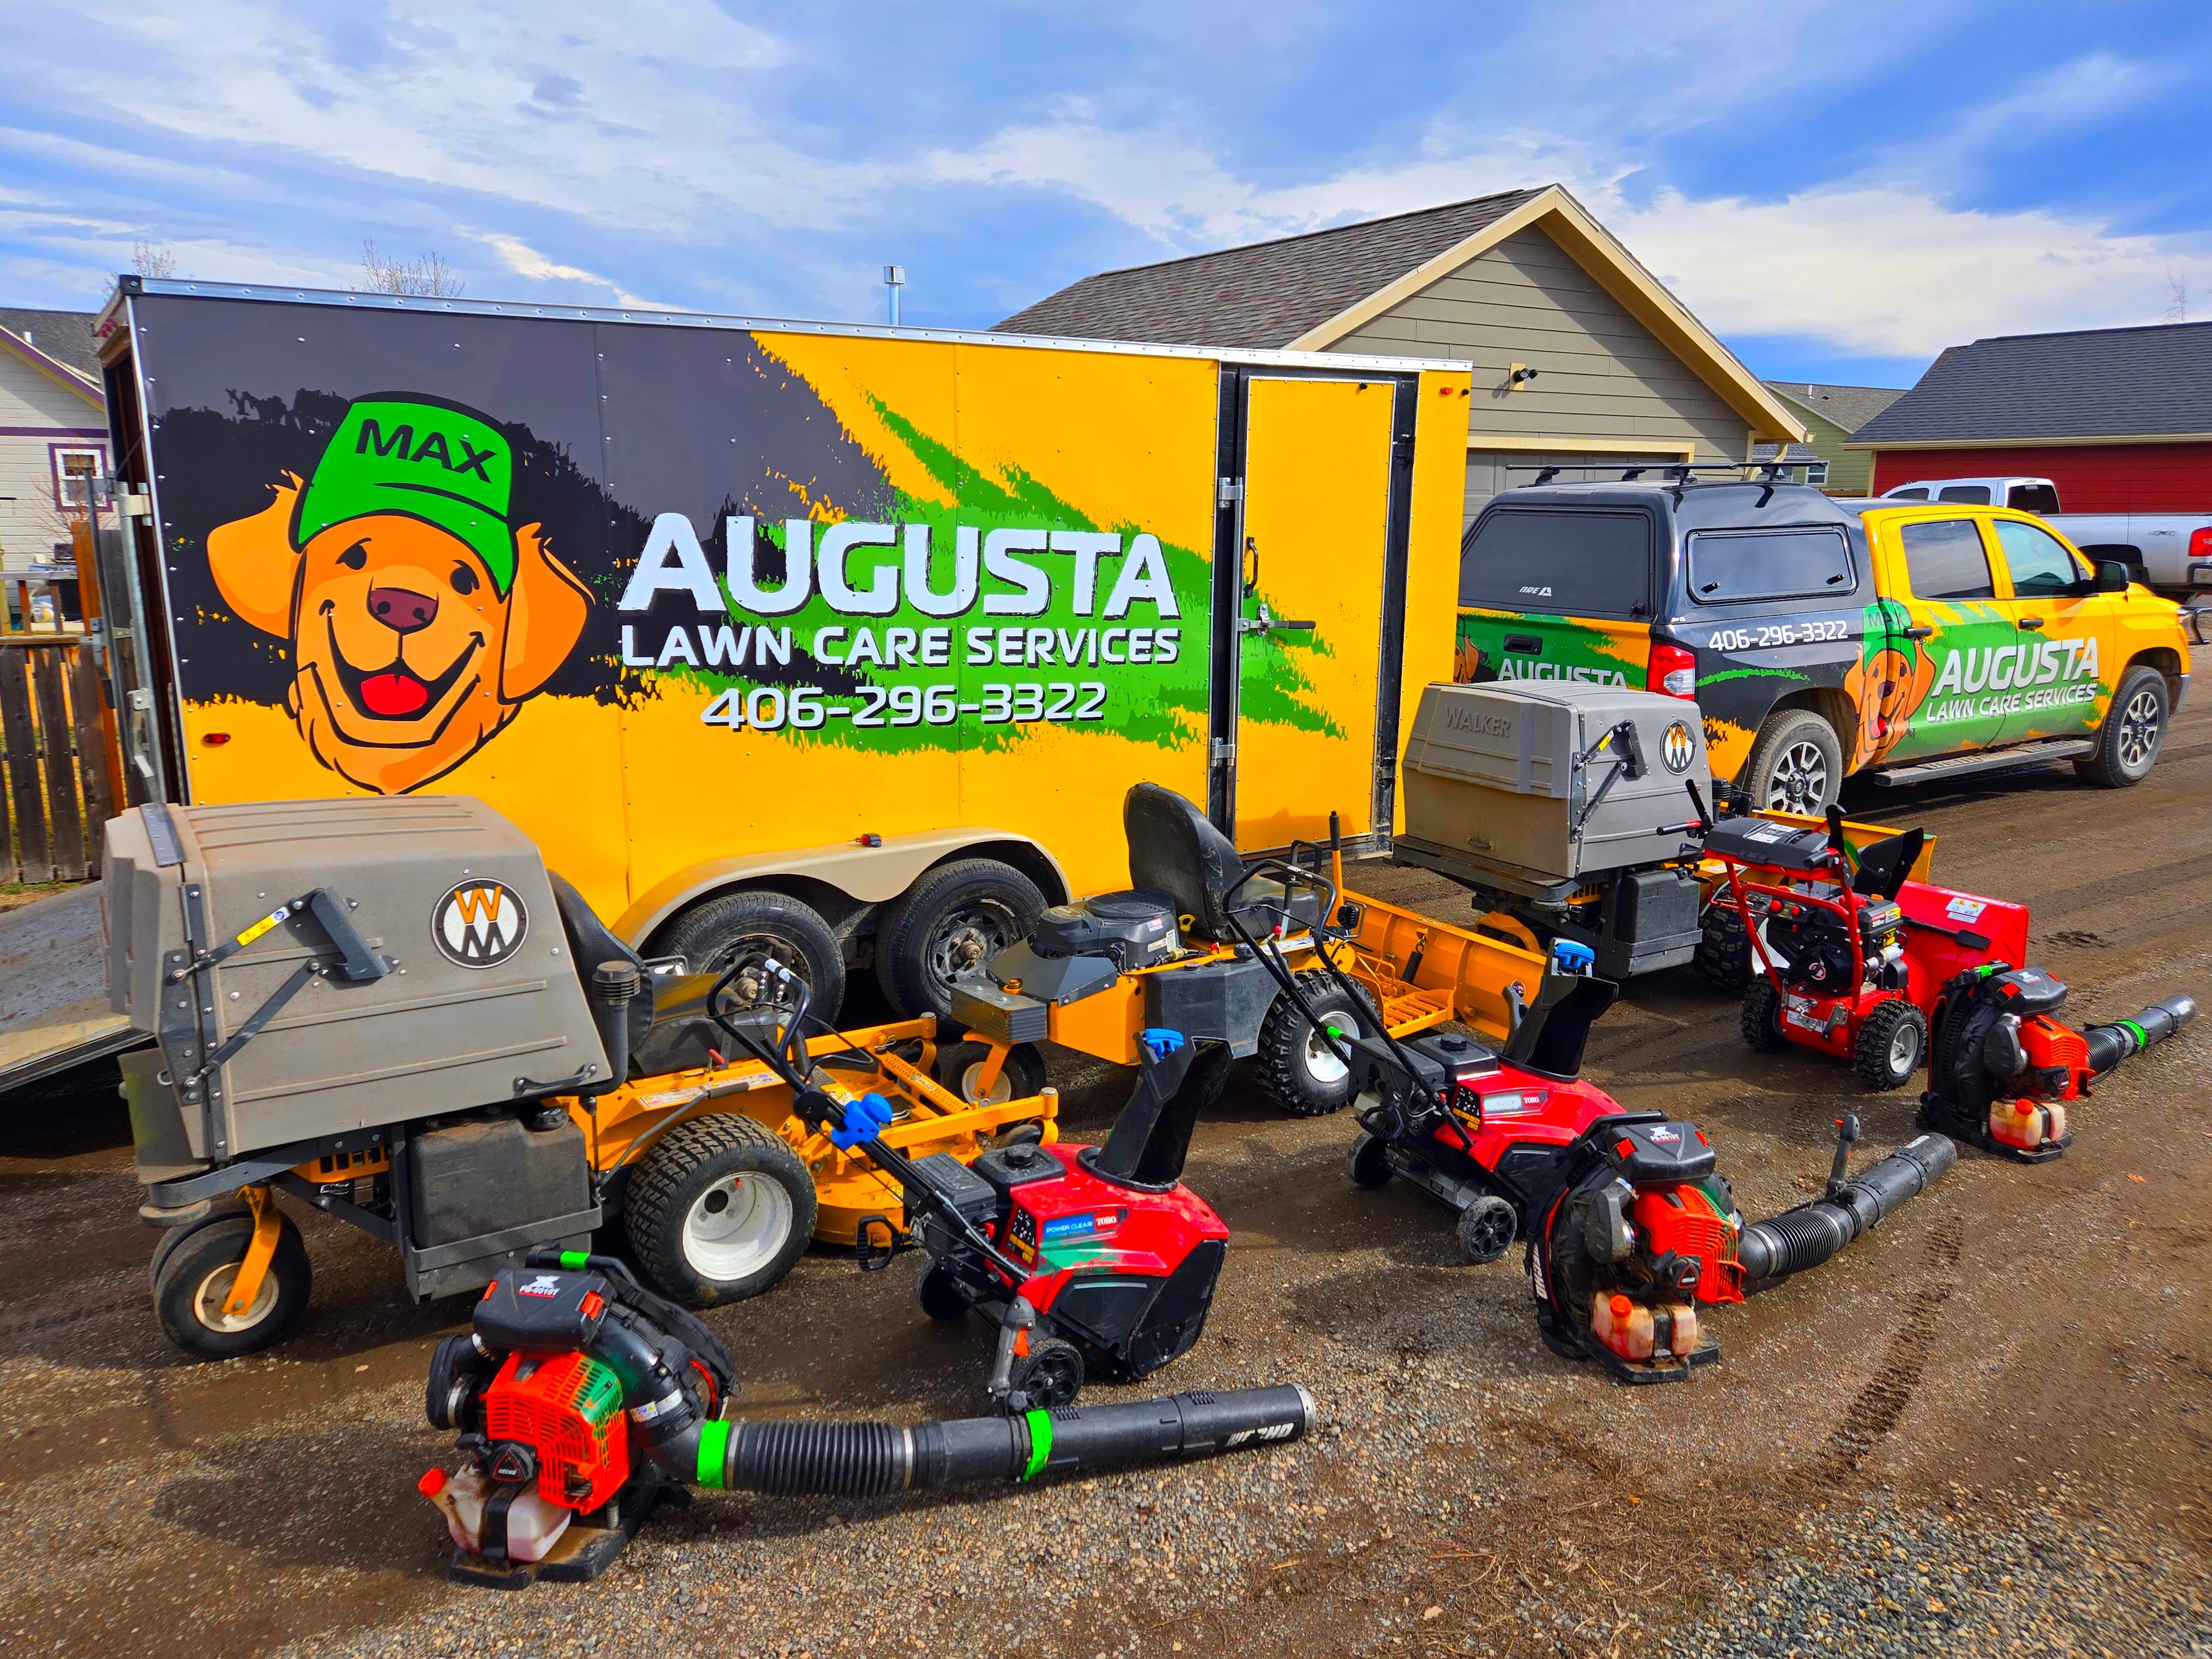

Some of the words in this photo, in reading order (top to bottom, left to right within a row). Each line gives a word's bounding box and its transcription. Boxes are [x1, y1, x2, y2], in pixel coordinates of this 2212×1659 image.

[355, 418, 497, 484] MAX
[618, 512, 1181, 618] AUGUSTA
[619, 624, 792, 667] LAWN
[814, 627, 952, 667] CARE
[967, 627, 1180, 666] SERVICES
[1709, 620, 1848, 651] 406-296-3322
[1931, 637, 2100, 698] AUGUSTA
[700, 682, 1108, 730] 406-296-3322
[1444, 706, 1510, 738] WALKER
[1926, 698, 1976, 722] LAWN
[1979, 692, 2022, 717] CARE
[2025, 684, 2098, 711] SERVICES
[1046, 1225, 1070, 1233] POWER
[1071, 1221, 1093, 1229] CLEAR
[1095, 1215, 1118, 1226] TORO
